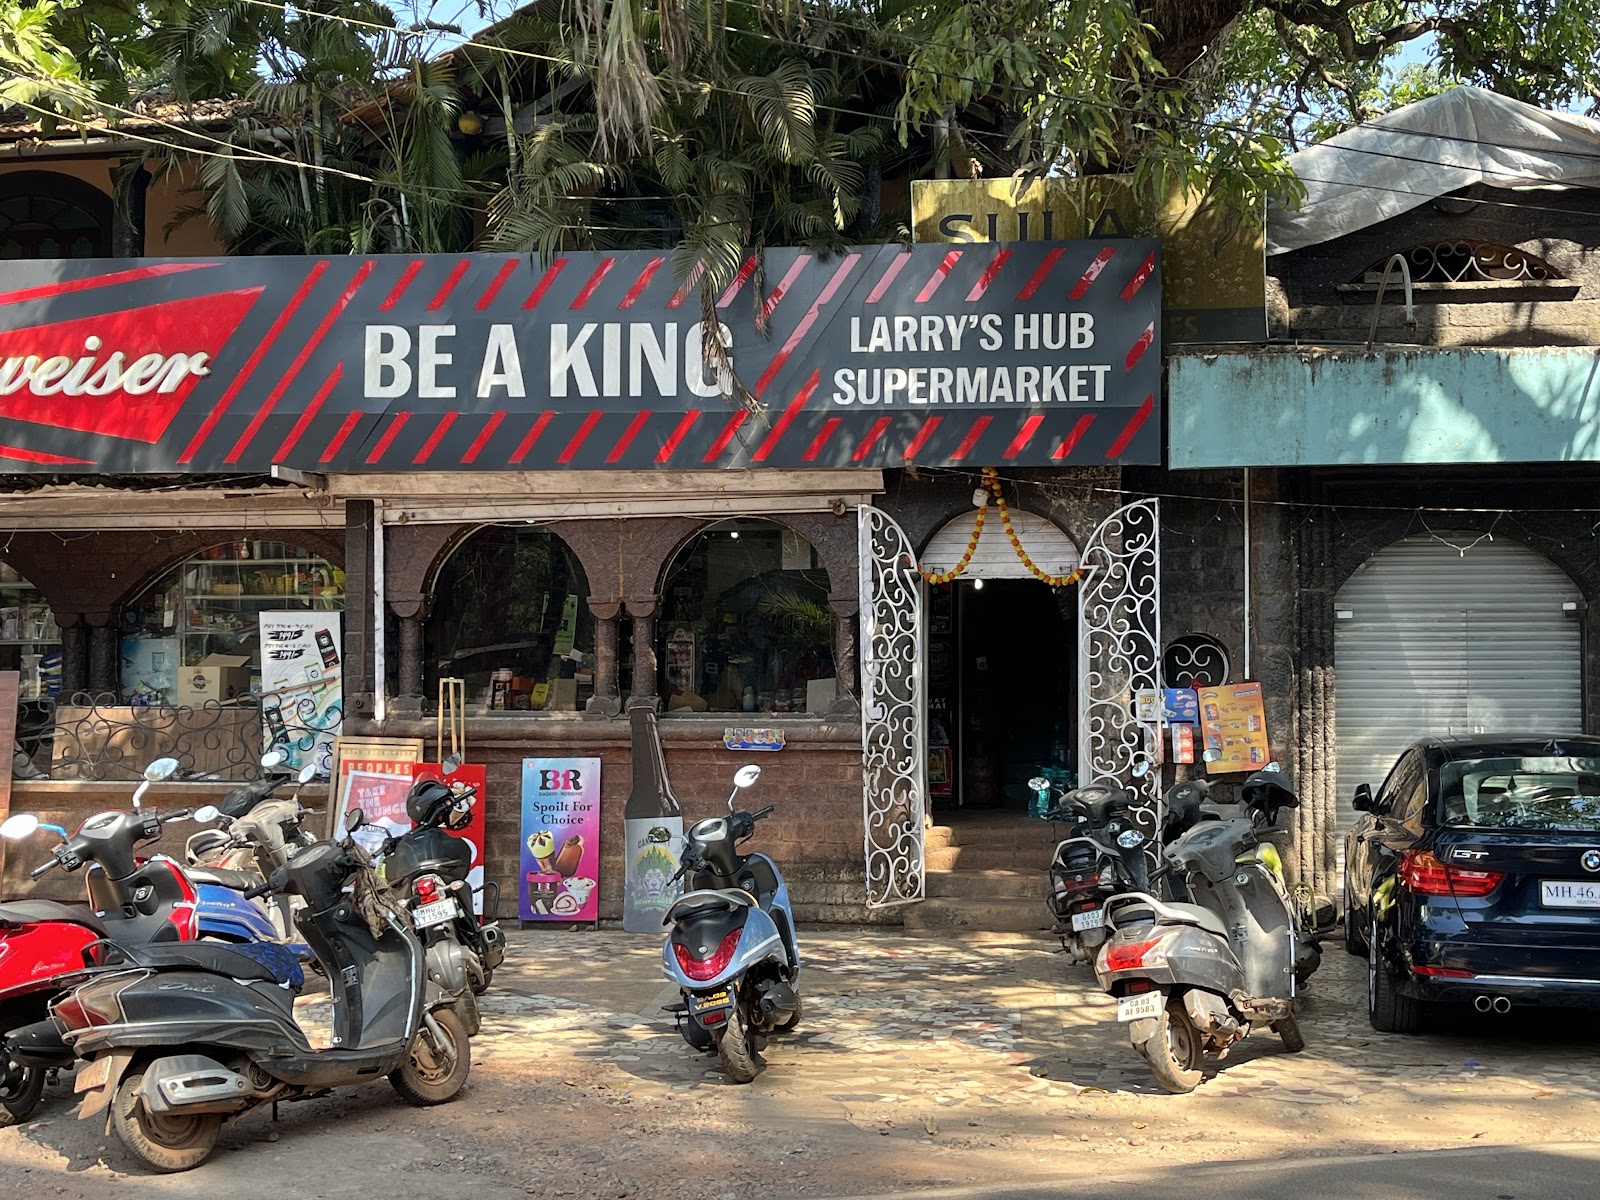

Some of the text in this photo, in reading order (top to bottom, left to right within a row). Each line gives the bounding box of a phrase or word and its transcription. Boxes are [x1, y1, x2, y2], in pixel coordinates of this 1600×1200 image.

[851, 312, 1095, 353] LARRY'S HUB
[364, 322, 734, 398] BE A KING
[832, 364, 1111, 405] SUPERMARKET
[347, 762, 410, 775] PEOPLES
[539, 769, 583, 790] BR
[357, 785, 386, 798] TAKE
[358, 797, 380, 808] THE
[533, 801, 593, 815] Spoilt For
[541, 814, 584, 825] Choice
[1453, 849, 1490, 859] GT
[1545, 885, 1600, 899] MH.46.
